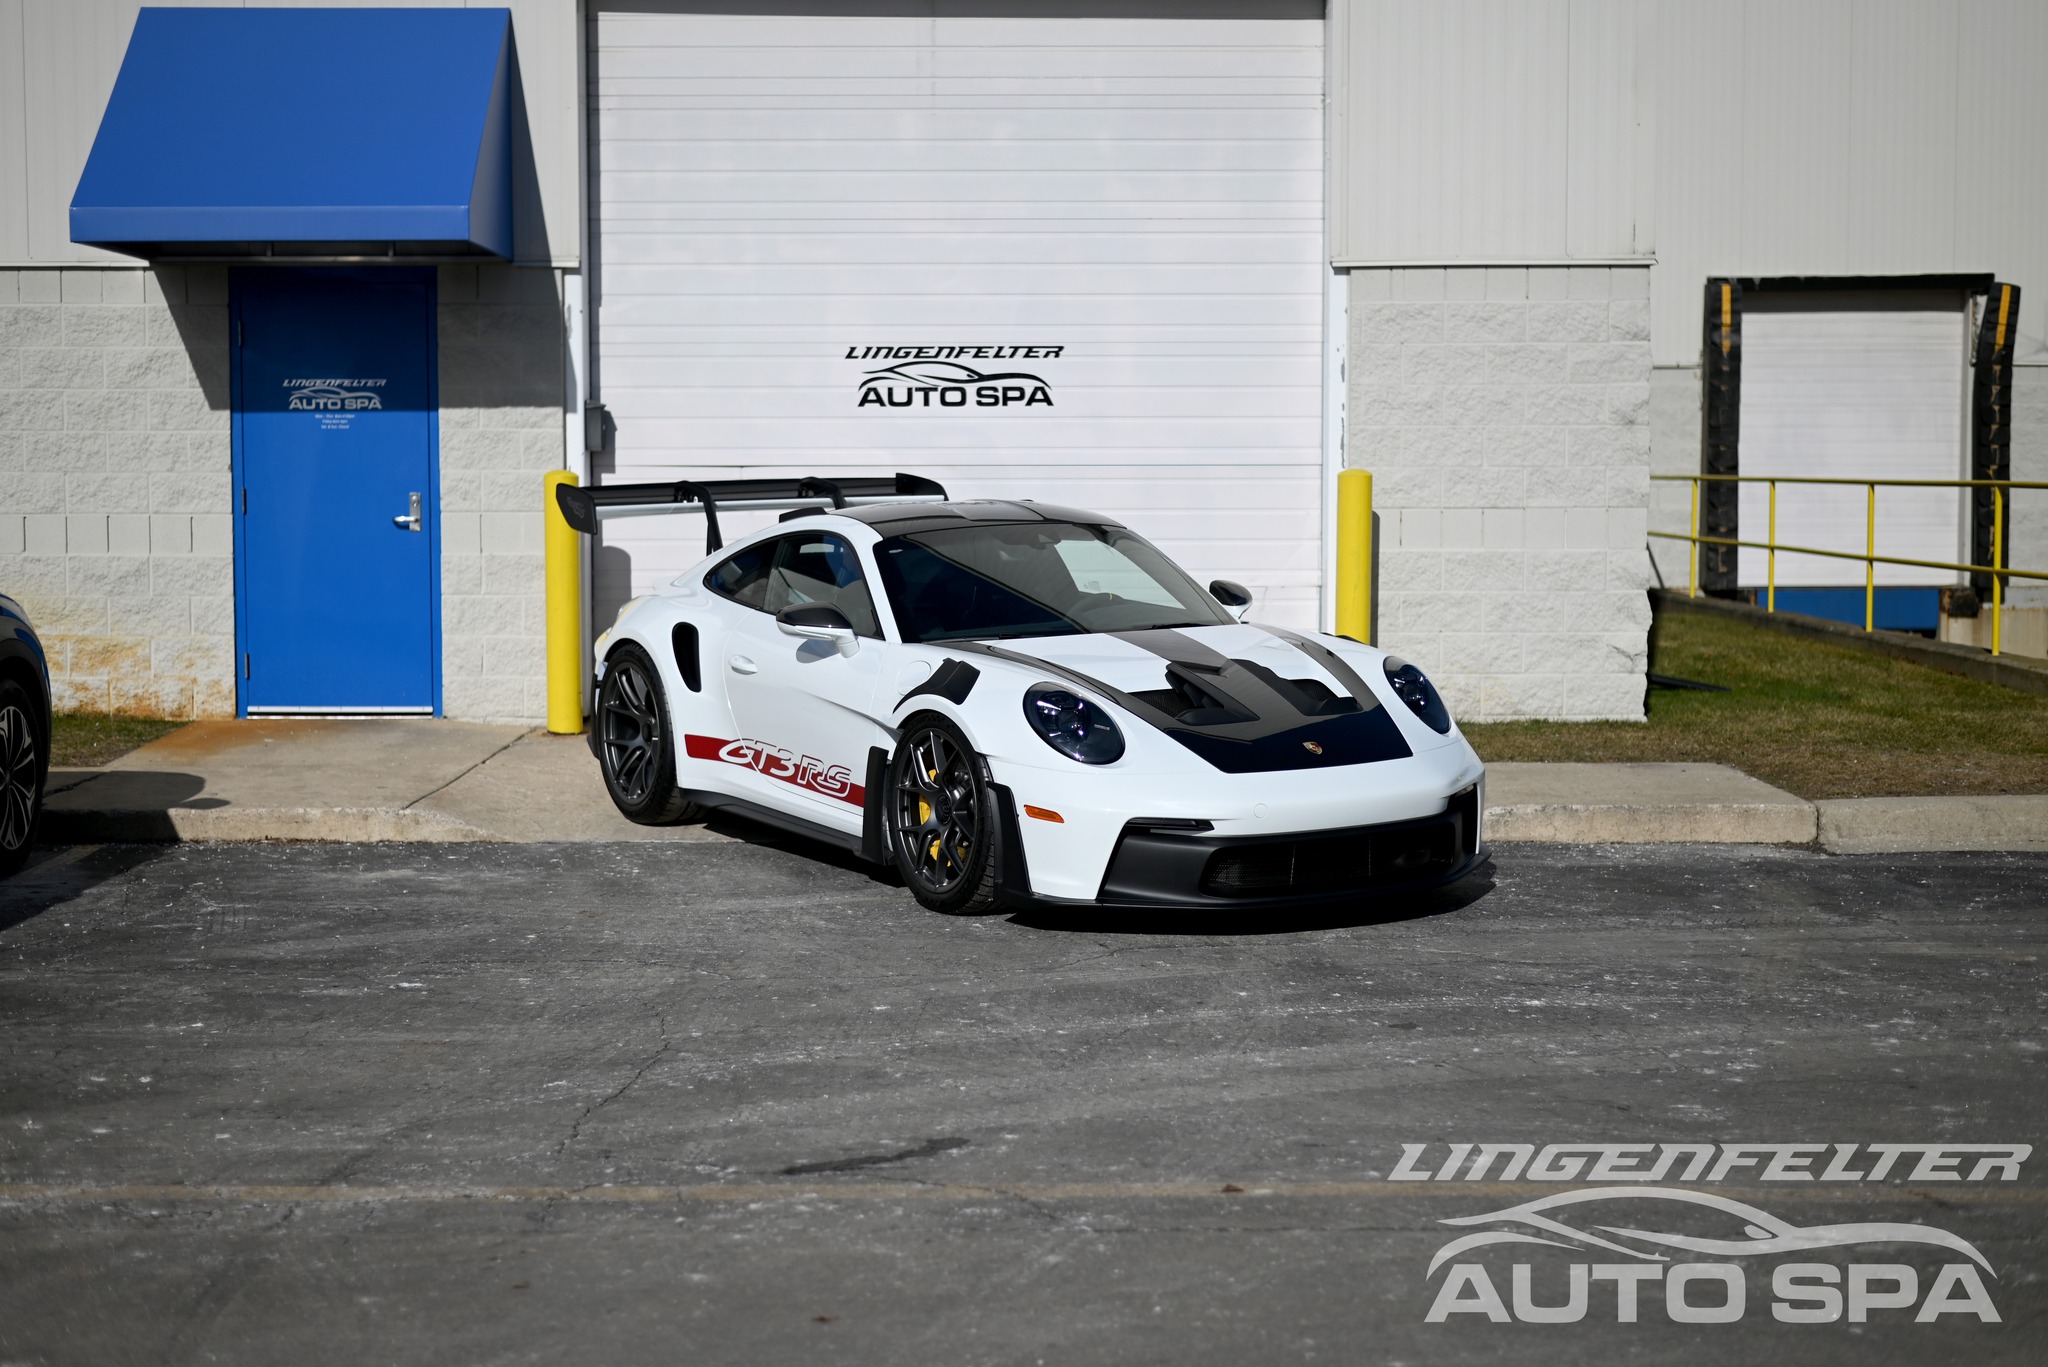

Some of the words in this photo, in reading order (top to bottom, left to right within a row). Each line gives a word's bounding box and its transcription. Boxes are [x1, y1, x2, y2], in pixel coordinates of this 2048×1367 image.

[844, 346, 1065, 359] LINGENFELTER
[282, 378, 387, 387] LINGENFELTER
[857, 386, 967, 407] AUTO
[975, 386, 1055, 407] SPA
[289, 398, 341, 410] AUTO
[344, 398, 382, 410] SPA
